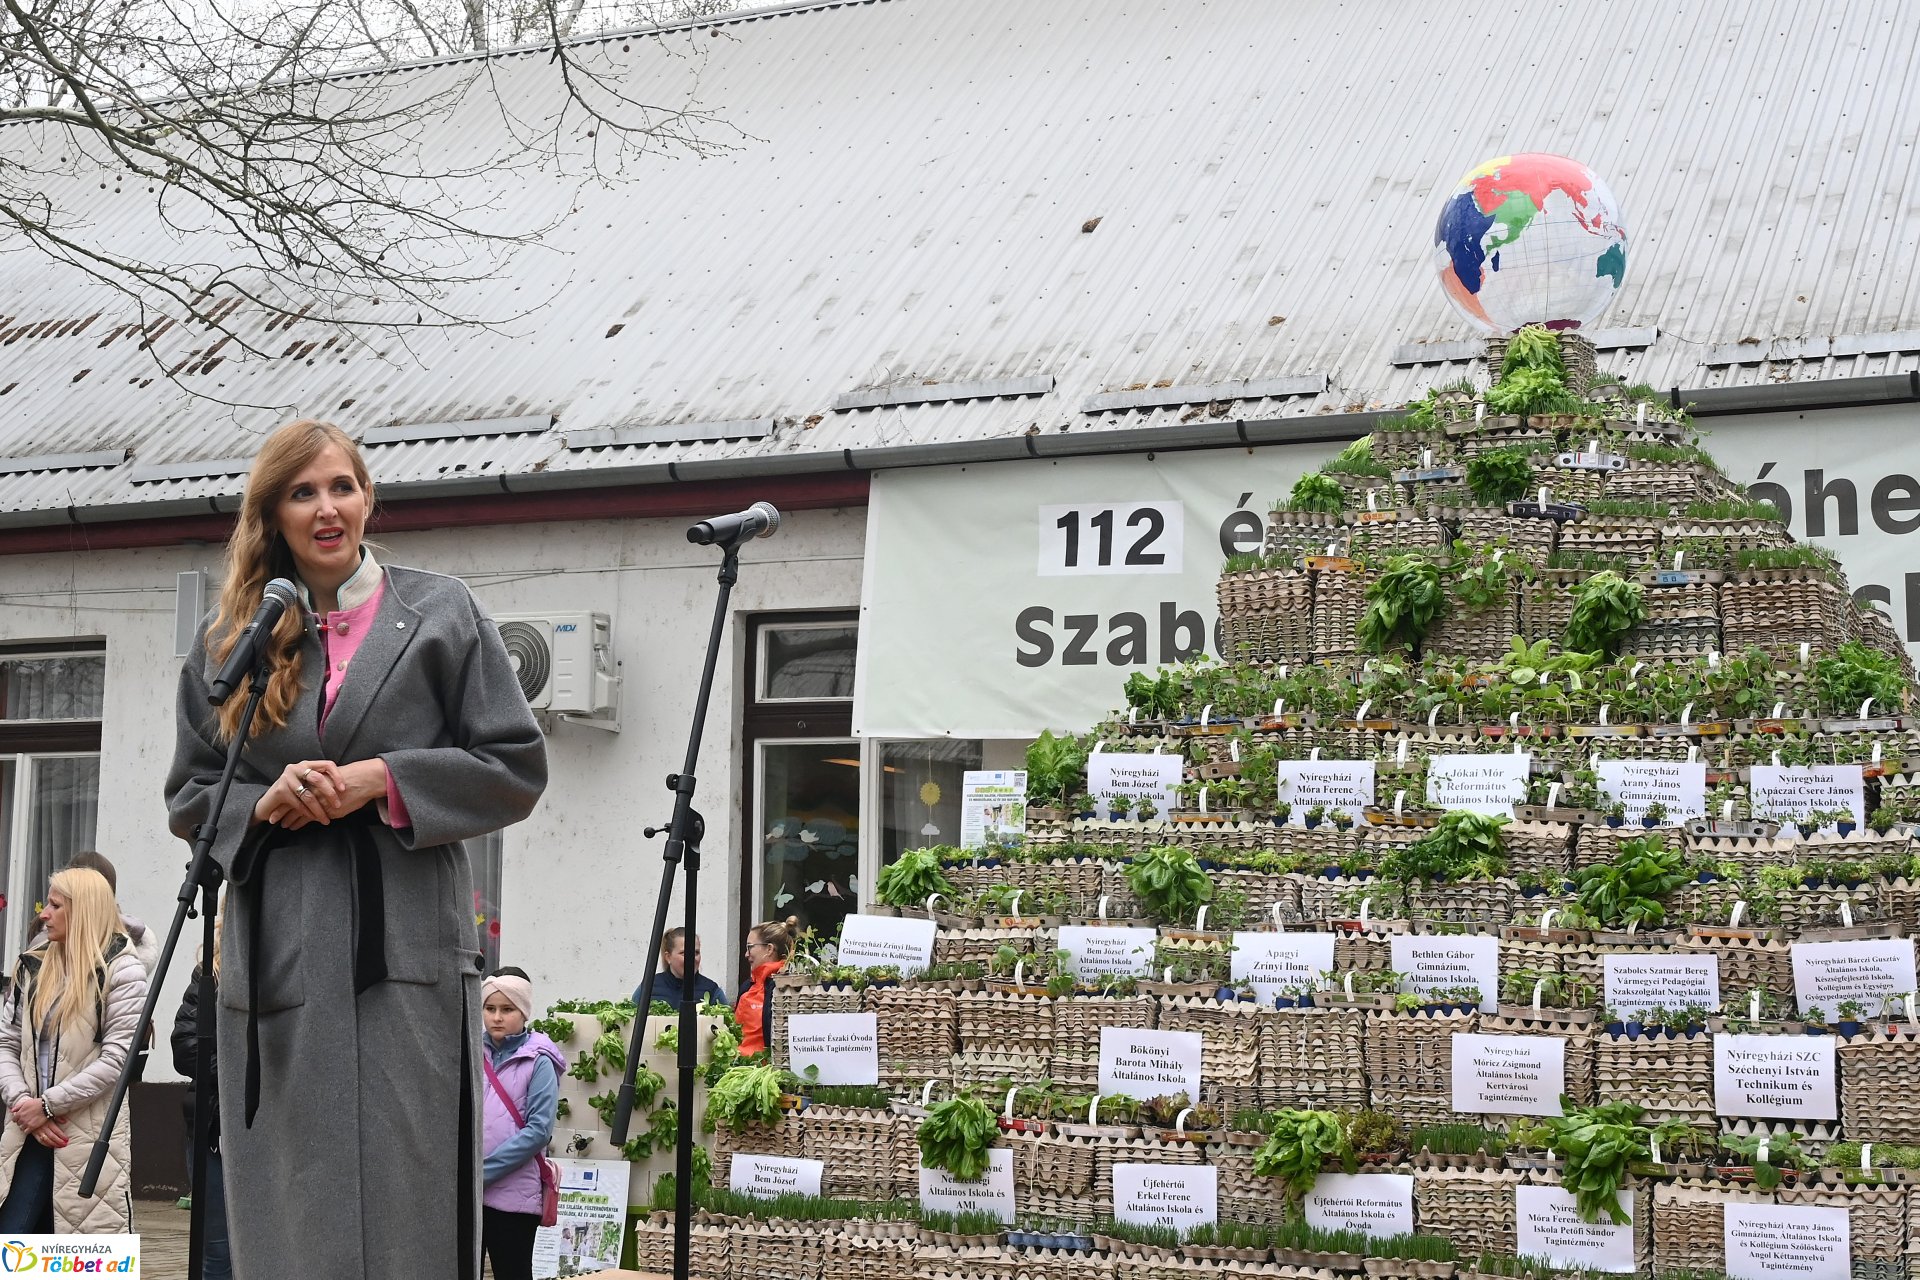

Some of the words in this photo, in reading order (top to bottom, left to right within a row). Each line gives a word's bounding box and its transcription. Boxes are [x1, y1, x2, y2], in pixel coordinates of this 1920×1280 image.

[1057, 507, 1165, 567] 112
[1015, 601, 1223, 668] Szab
[1110, 768, 1159, 778] Nyíregyházi
[1451, 769, 1478, 778] Jókai
[1482, 769, 1504, 777] Mór
[1624, 766, 1679, 776] Nyíregyházi
[1300, 772, 1352, 782] Nyíregyházi
[1779, 774, 1833, 784] Nyíregyházi
[1132, 780, 1158, 789] József
[1297, 785, 1320, 793] Móra
[1324, 785, 1353, 793] Ferenc
[1447, 782, 1506, 791] Református
[1620, 780, 1649, 789] Arany
[1099, 789, 1137, 800] Általános
[1140, 792, 1164, 800] Iskola
[1620, 791, 1680, 802] Gimnázium,
[1761, 787, 1795, 796] Apáczai
[1292, 798, 1332, 806] Általános
[1335, 798, 1362, 806] Iskola
[1486, 795, 1516, 804] Iskola
[1624, 804, 1650, 812] lános
[844, 939, 881, 949] Nyíregyházi
[884, 942, 903, 951] Zrínyi
[905, 944, 921, 952] Ilona
[1086, 938, 1126, 946] Nyíregyházi
[843, 948, 879, 957] Gimnázium
[889, 952, 922, 961] Kollégium
[1266, 949, 1298, 959] Apagyi
[1079, 955, 1109, 964] Általános
[1806, 958, 1846, 966] Nyíregyházi
[1254, 962, 1282, 972] Zrínyi
[1286, 962, 1309, 971] Ilona
[1417, 963, 1469, 972] Gimnázium,
[1246, 972, 1287, 983] Általános
[1291, 975, 1318, 984] Iskol
[1409, 974, 1447, 982] Általános
[1450, 975, 1478, 983] Iskola,
[1618, 978, 1659, 986] Vármegyei
[1662, 978, 1705, 986] Pedagógiai
[1414, 984, 1431, 994] Óvo
[1612, 988, 1665, 996] Szakszolgálat
[1668, 988, 1710, 997] Nagykállói
[1818, 984, 1852, 992] Kollégium
[1863, 983, 1893, 991] Egységes
[1805, 993, 1863, 1001] Gyógypedagógiai
[1680, 999, 1712, 1008] Balkány
[828, 1033, 848, 1041] Északi
[851, 1033, 872, 1041] Óvoda
[794, 1045, 824, 1053] Nyitnikék
[826, 1044, 872, 1052] Tagintézmény
[1130, 1045, 1169, 1057] Bökönyi
[1484, 1046, 1530, 1056] Nyíregyházi
[1728, 1050, 1792, 1062] Nyíregyházi
[1796, 1052, 1820, 1062] SZC
[1116, 1057, 1146, 1067] Barota
[1150, 1060, 1183, 1072] Mihály
[1473, 1059, 1499, 1067] Móricz
[1502, 1060, 1541, 1069] Zsigmond
[1111, 1068, 1154, 1081] Általános
[1158, 1074, 1186, 1083] Iskola
[1476, 1069, 1512, 1078] Általános
[1515, 1072, 1538, 1080] Iskola
[1728, 1064, 1782, 1077] Széchenyi
[1786, 1066, 1819, 1076] István
[1486, 1082, 1528, 1090] Kertvárosi
[1736, 1079, 1798, 1090] Technikum
[1802, 1082, 1812, 1090] és
[1478, 1092, 1538, 1104] Tagintézménye
[1746, 1094, 1802, 1106] Kollégium
[754, 1163, 798, 1174] Nyíregyházi
[755, 1174, 770, 1183] Bem
[773, 1177, 796, 1185] József
[1144, 1177, 1184, 1189] Újfehértói
[745, 1182, 780, 1195] Általános
[928, 1184, 966, 1196] Általános
[969, 1188, 994, 1197] Iskola
[997, 1189, 1005, 1197] és
[1138, 1192, 1160, 1200] Erkel
[1163, 1192, 1190, 1201] Ferenc
[1314, 1196, 1353, 1206] Újfehértói
[1356, 1198, 1402, 1207] Református
[956, 1201, 976, 1210] AMI
[1126, 1201, 1164, 1212] Általános
[1167, 1205, 1192, 1213] Iskola
[1195, 1205, 1203, 1213] és
[1322, 1206, 1358, 1218] Általános
[1361, 1210, 1384, 1218] Iskola
[1155, 1216, 1173, 1225] AMI
[1529, 1214, 1550, 1222] Móra
[1346, 1220, 1372, 1229] Óvoda
[1739, 1220, 1784, 1229] Nyíregyházi
[1786, 1222, 1809, 1232] Arany
[1534, 1225, 1558, 1233] Iskola
[1561, 1226, 1584, 1235] Petőfi
[1586, 1227, 1615, 1236] Sándor
[1732, 1229, 1778, 1239] Gimnázium,
[1780, 1230, 1816, 1240] Általános
[1819, 1234, 1841, 1242] Iskola
[1544, 1237, 1604, 1248] Tagintézménye
[1750, 1241, 1788, 1250] Kollégium
[1791, 1242, 1833, 1252] Szőlőskerti
[1774, 1252, 1824, 1262] Kéttannyelvű
[1760, 1261, 1813, 1271] Tagintézmény
